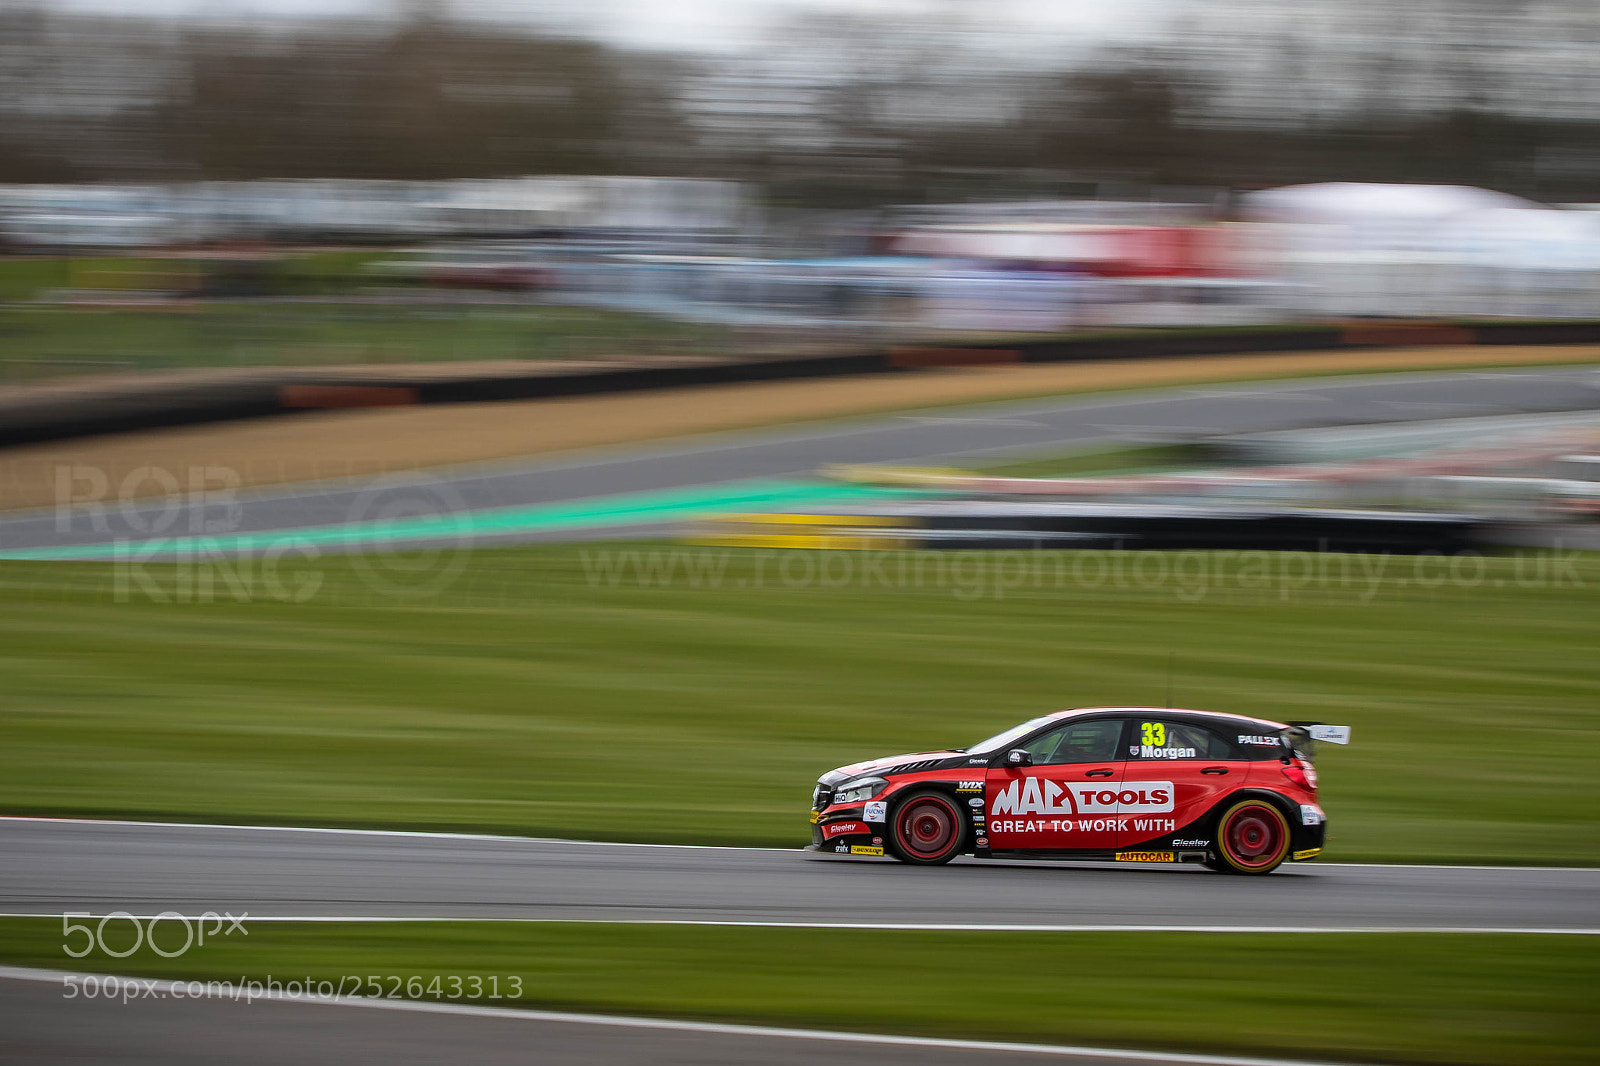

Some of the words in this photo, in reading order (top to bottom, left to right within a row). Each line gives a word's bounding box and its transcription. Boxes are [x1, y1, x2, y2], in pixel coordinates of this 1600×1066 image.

[1141, 723, 1165, 747] 33
[1141, 745, 1196, 759] Morgan
[959, 781, 984, 789] WIX
[991, 777, 1072, 815] MAC
[1080, 789, 1169, 805] TOOLS
[991, 820, 1046, 832] GREAT
[1051, 820, 1073, 832] TO
[1079, 819, 1129, 832] WORK
[1134, 819, 1175, 831] WITH
[1118, 853, 1172, 862] AUTOCAR
